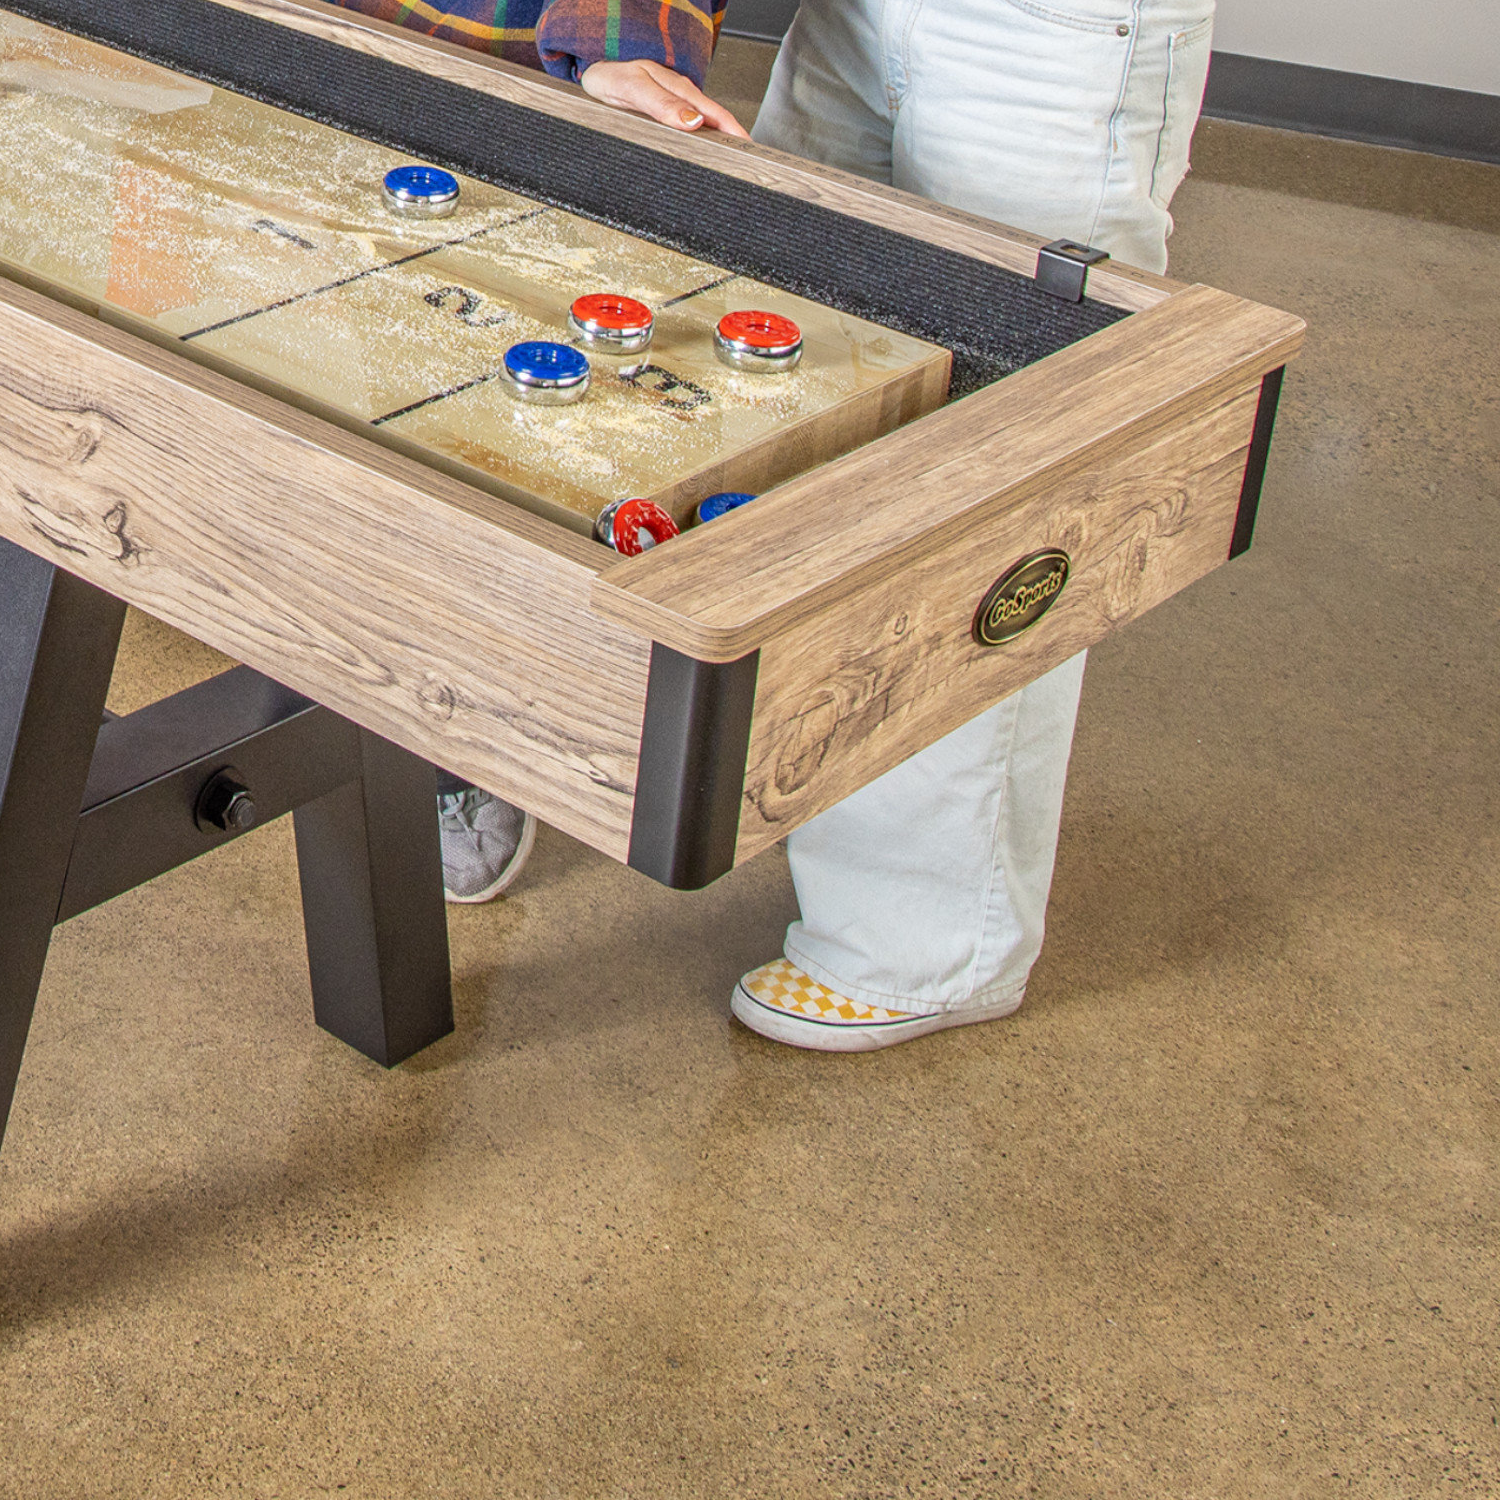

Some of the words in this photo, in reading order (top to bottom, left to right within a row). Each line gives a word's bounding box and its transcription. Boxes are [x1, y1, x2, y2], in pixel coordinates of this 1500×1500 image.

[422, 285, 514, 328] 2
[618, 363, 713, 412] 3
[988, 570, 1063, 628] GoSports
